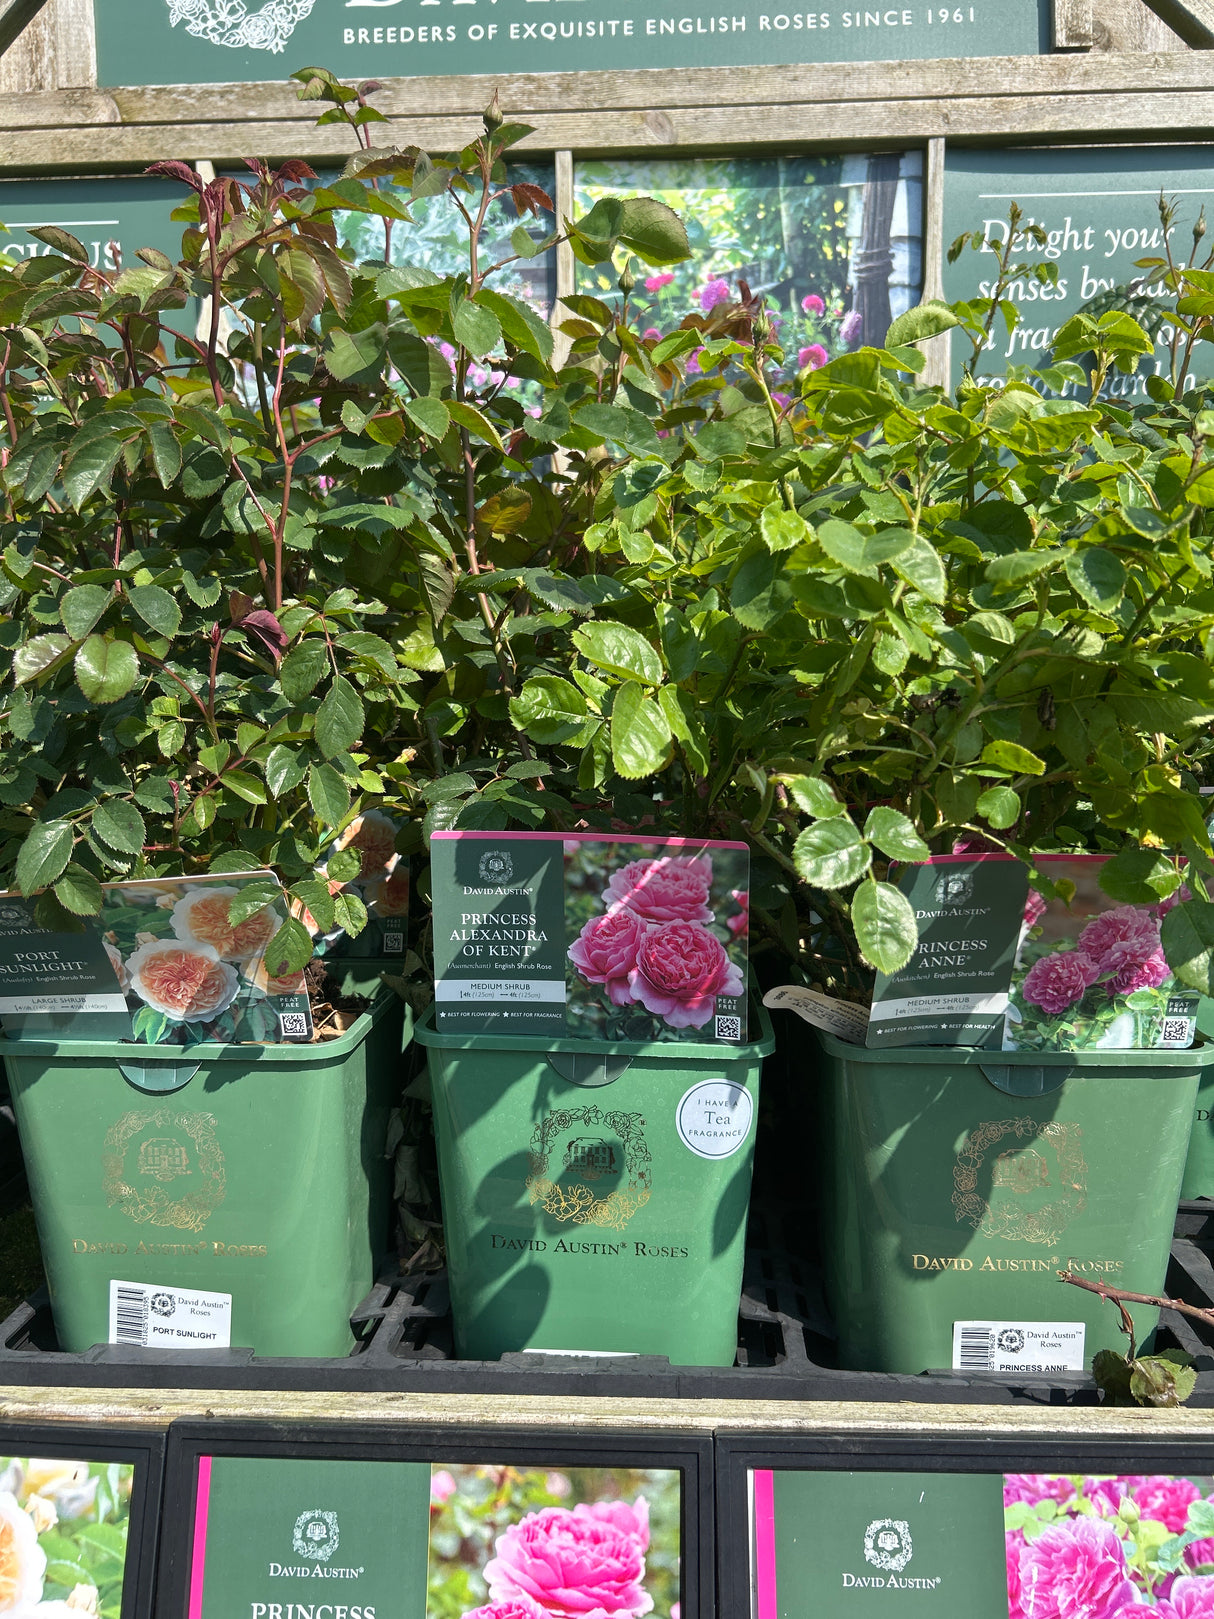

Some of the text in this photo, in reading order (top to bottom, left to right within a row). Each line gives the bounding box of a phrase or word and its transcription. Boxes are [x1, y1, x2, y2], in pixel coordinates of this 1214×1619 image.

[343, 7, 975, 44] BREEDERS OF EXQUISITE ENGLISH ROSES SINCE 1961
[1104, 227, 1176, 257] your
[976, 279, 1068, 301] senses
[463, 886, 494, 895] DAVID
[461, 913, 537, 926] PRINCESS
[916, 910, 948, 919] DAVID
[449, 929, 548, 941] ALEXANDRA
[14, 950, 60, 962] PORT
[463, 945, 483, 956] OF
[494, 963, 515, 971] English
[516, 962, 535, 970] Shrub
[933, 972, 956, 980] English
[907, 999, 940, 1007] MEDIUM
[705, 1099, 729, 1107] HAVE
[704, 1110, 731, 1125] Tea
[688, 1129, 743, 1138] FRAGRANCE
[71, 1239, 128, 1255] DAVID
[212, 1241, 267, 1257] ROSES
[491, 1234, 547, 1252] DAVID
[634, 1242, 689, 1258] ROSES
[911, 1254, 973, 1271] DAVID
[1067, 1257, 1125, 1274] ROSES
[178, 1297, 199, 1306] David
[190, 1308, 211, 1316] Roses
[152, 1326, 217, 1340] PORT SUNLIGHT
[1027, 1331, 1049, 1339] David
[268, 1562, 310, 1577] DAVID
[842, 1573, 885, 1588] DAVID
[250, 1602, 376, 1619] PRINCESS
